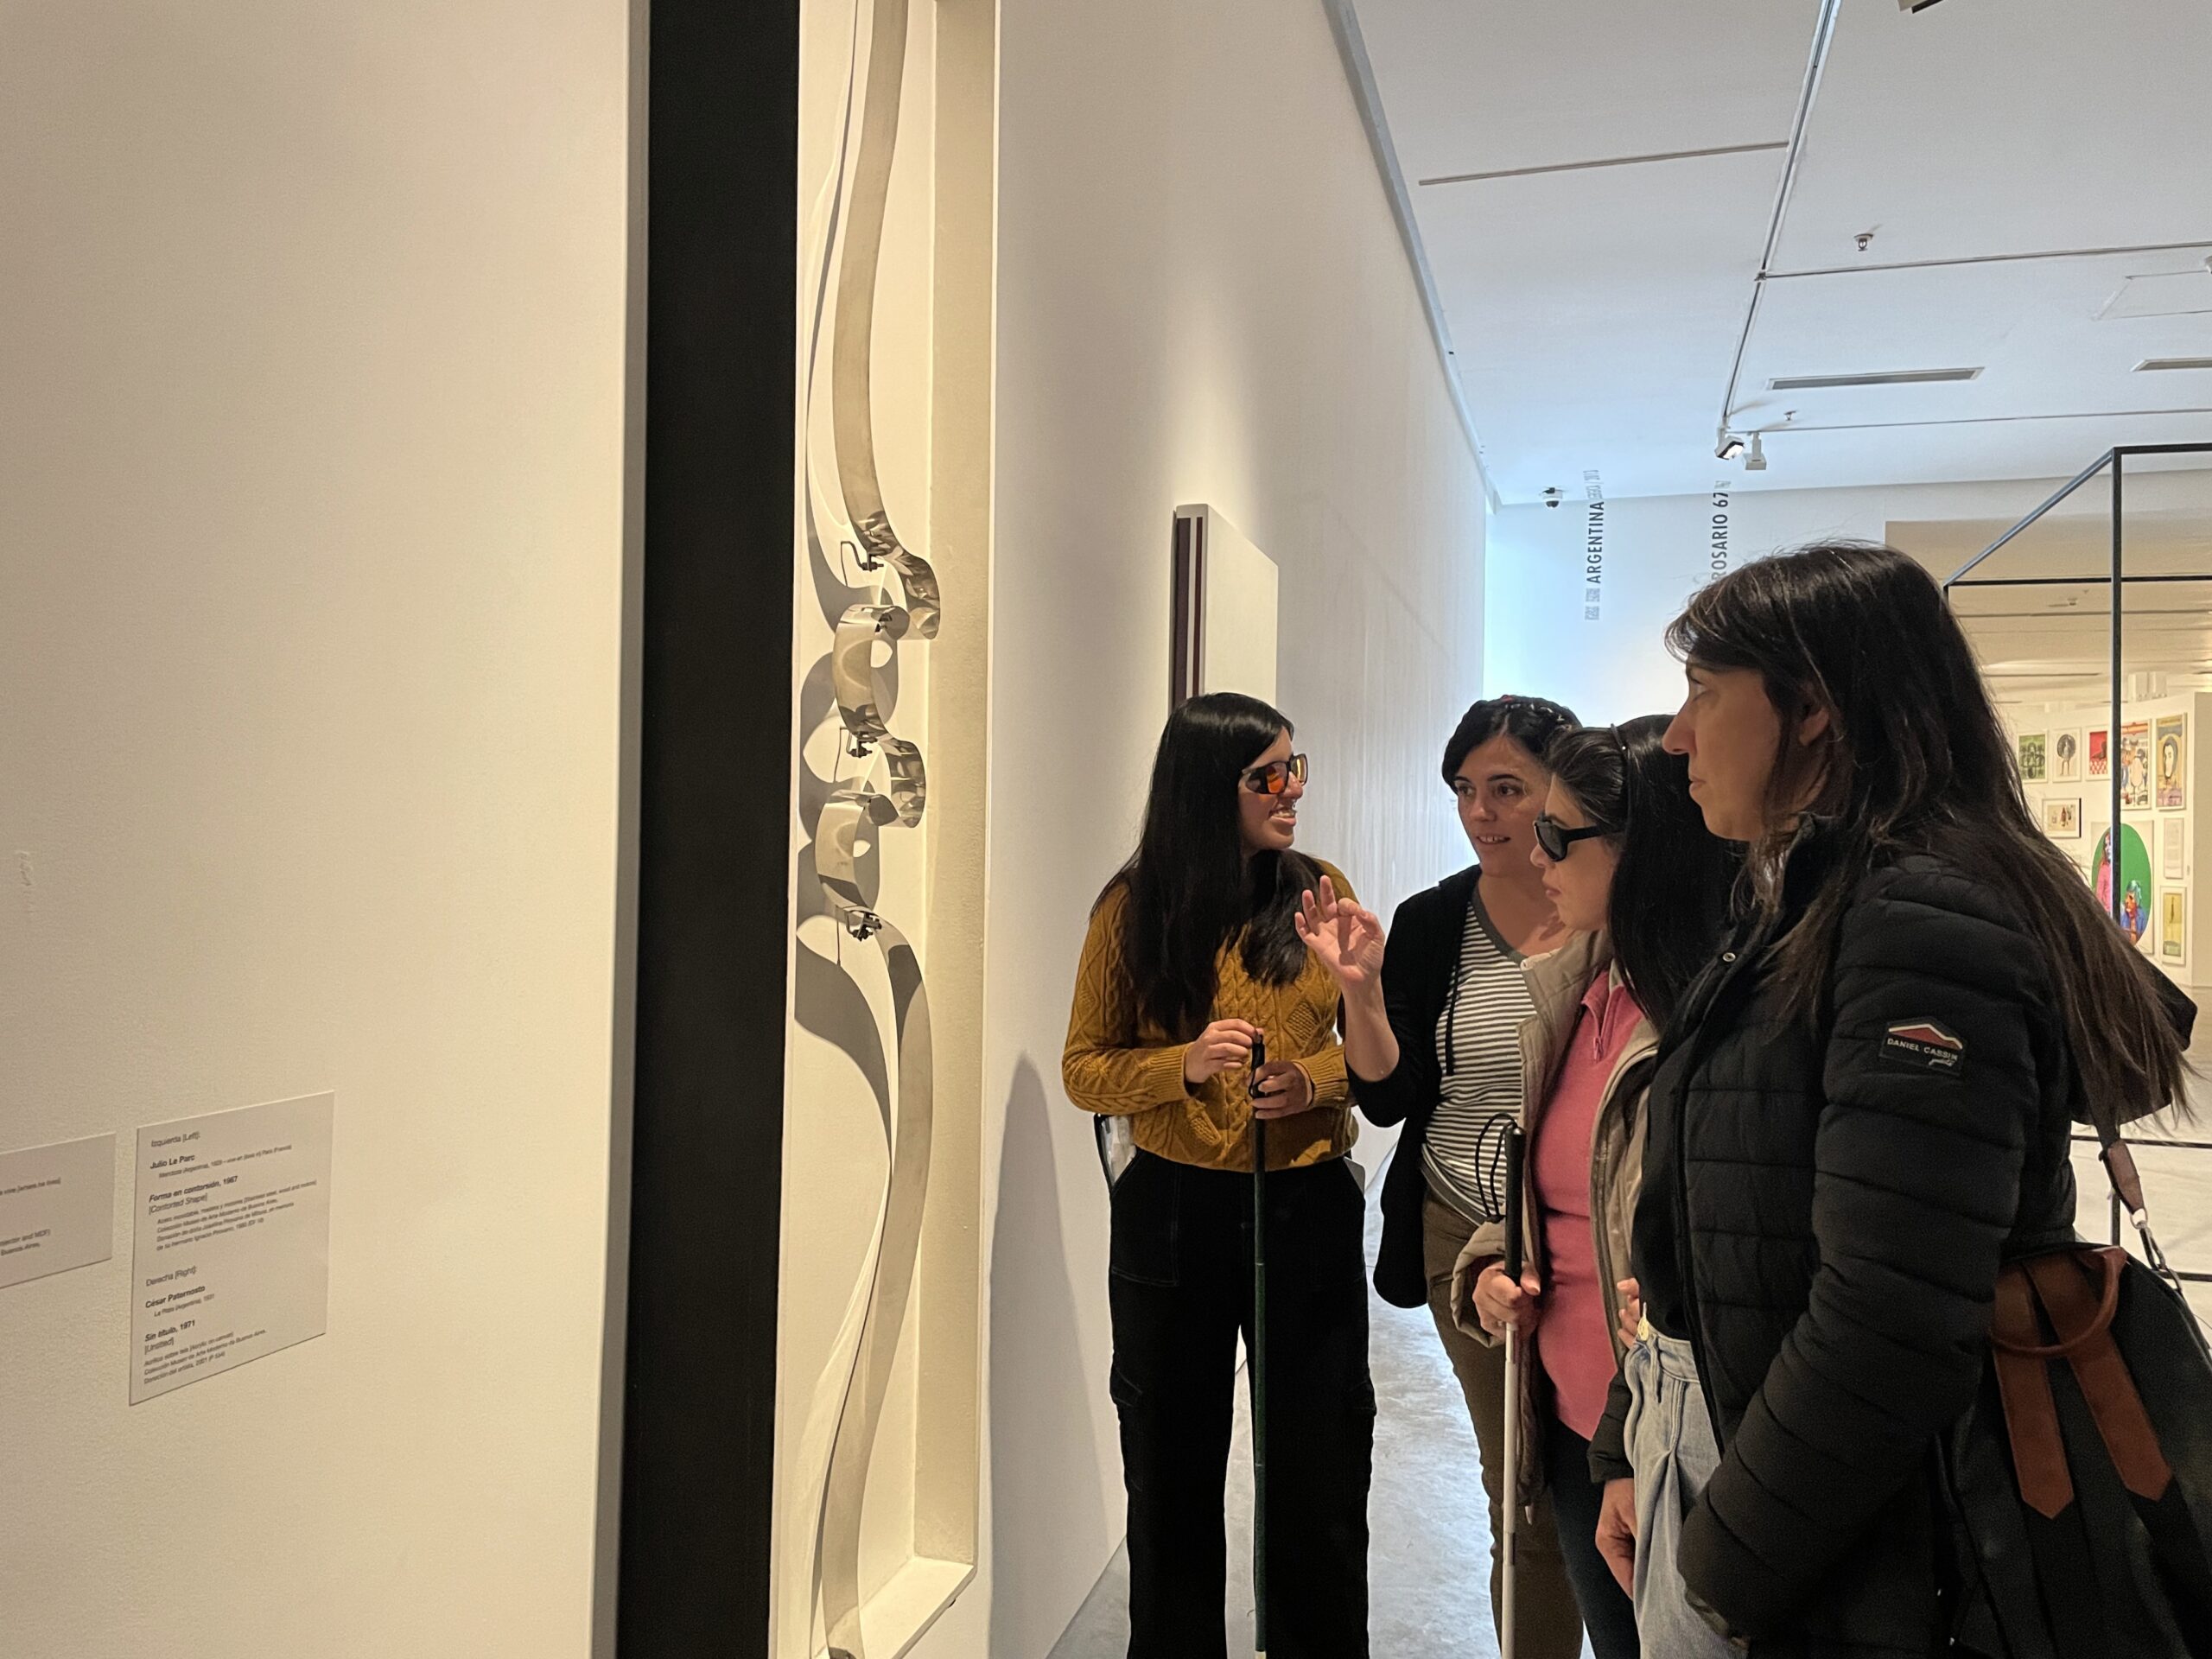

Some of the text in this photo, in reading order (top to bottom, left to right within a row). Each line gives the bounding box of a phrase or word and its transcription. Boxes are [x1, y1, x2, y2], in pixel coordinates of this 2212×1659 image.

[1713, 492, 1728, 507] 67
[1586, 501, 1605, 584] ARGENTINA
[1711, 514, 1728, 580] ROSARIO
[1887, 1038, 1958, 1061] DANIEL CASSIN
[150, 1160, 167, 1169] Julio
[179, 1154, 195, 1163] Parc
[149, 1192, 171, 1203] Forma
[146, 1274, 174, 1287] Derecha
[145, 1286, 206, 1308] César Paternosto
[145, 1333, 156, 1342] Sin
[180, 1319, 195, 1330] 1971
